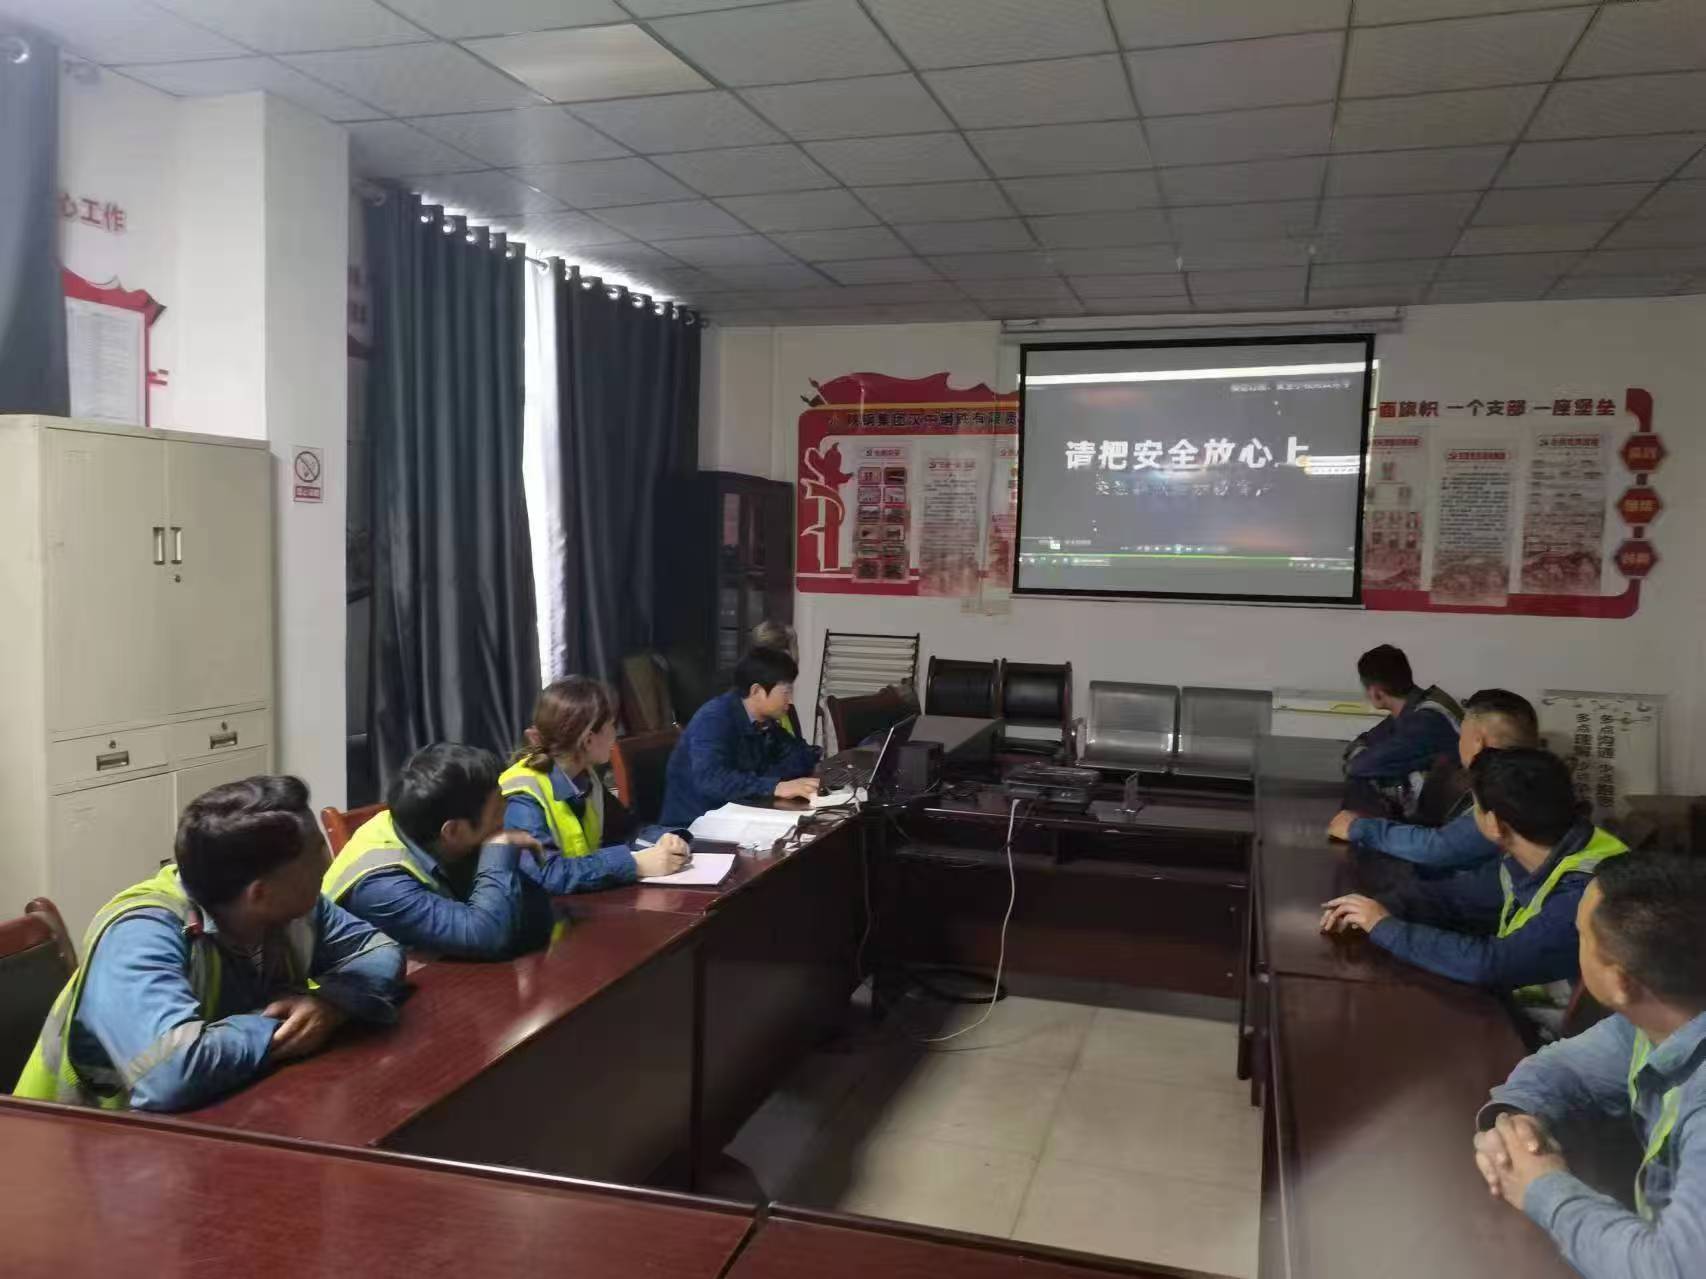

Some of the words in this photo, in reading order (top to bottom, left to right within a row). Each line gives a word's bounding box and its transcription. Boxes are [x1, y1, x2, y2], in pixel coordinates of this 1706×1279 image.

[1447, 399, 1526, 417] 一个支部
[1533, 398, 1616, 417] 一座堡垒
[1064, 436, 1310, 470] 请把安全放心上
